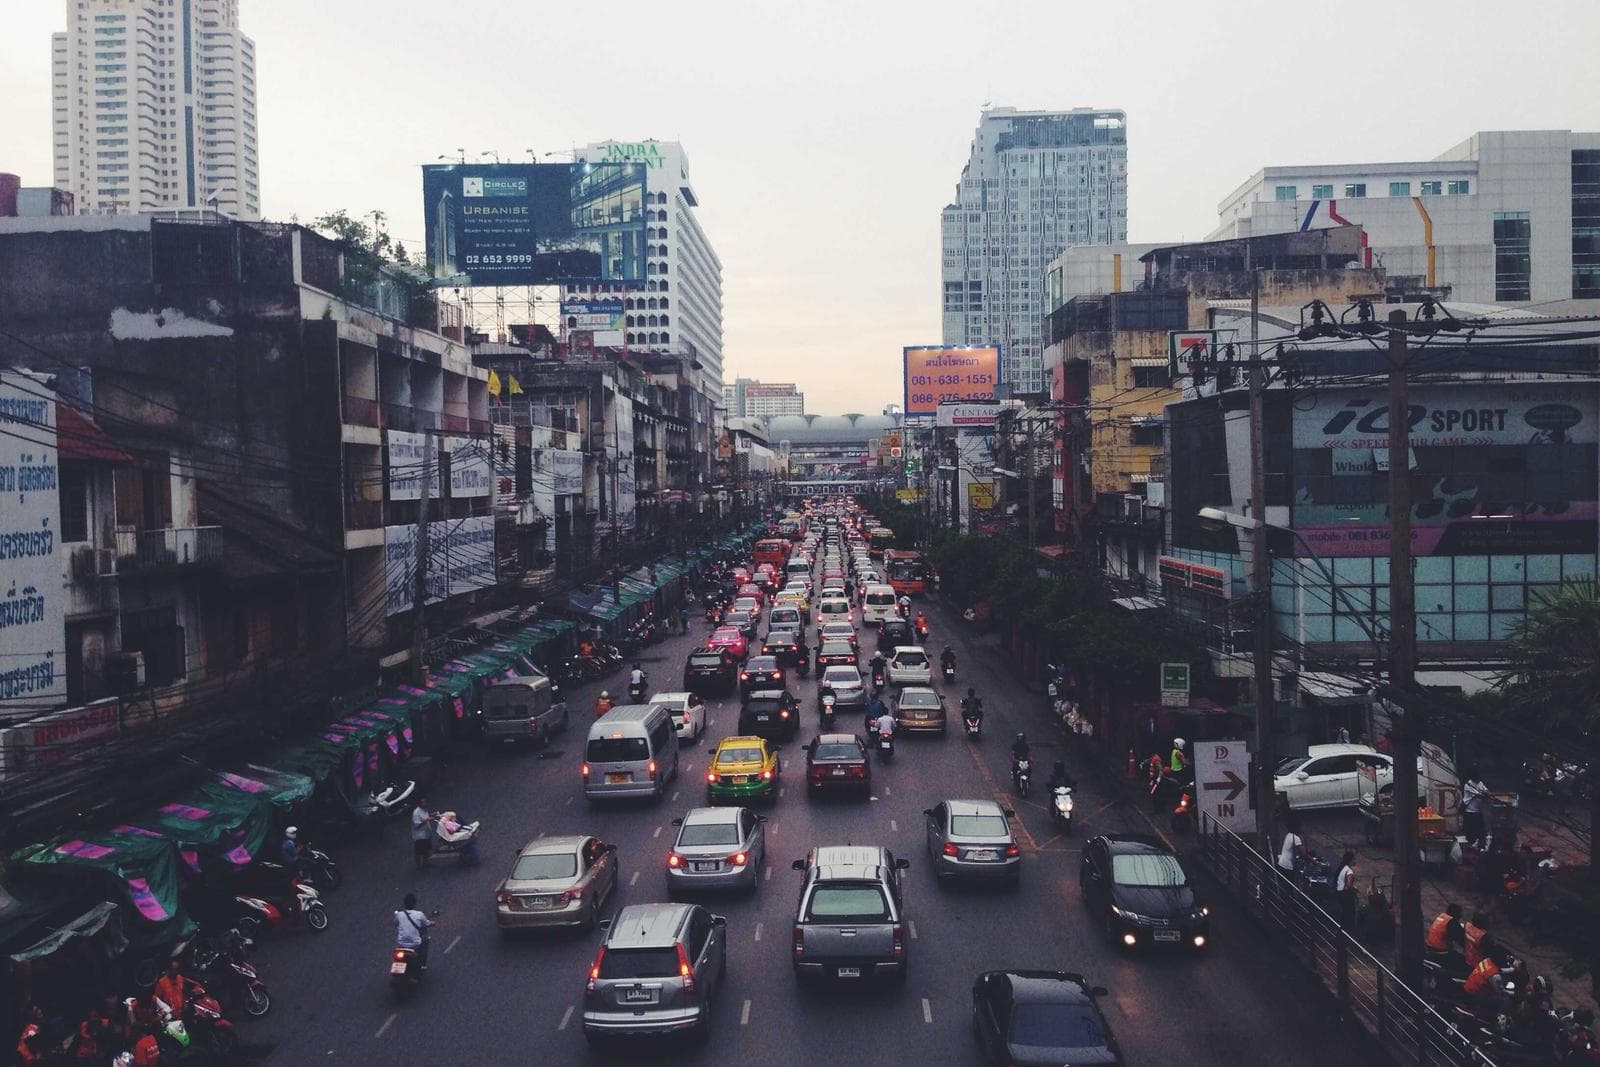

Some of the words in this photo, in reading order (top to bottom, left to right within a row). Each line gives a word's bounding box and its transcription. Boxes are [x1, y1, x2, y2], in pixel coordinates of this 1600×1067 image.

[608, 144, 658, 157] INDRA
[463, 206, 529, 215] URBANISE
[466, 255, 480, 264] 02
[482, 255, 503, 264] 652
[505, 254, 532, 264] 9999
[911, 375, 993, 386] 081-638-1551
[1431, 408, 1508, 432] SPORT
[1217, 804, 1235, 817] IN
